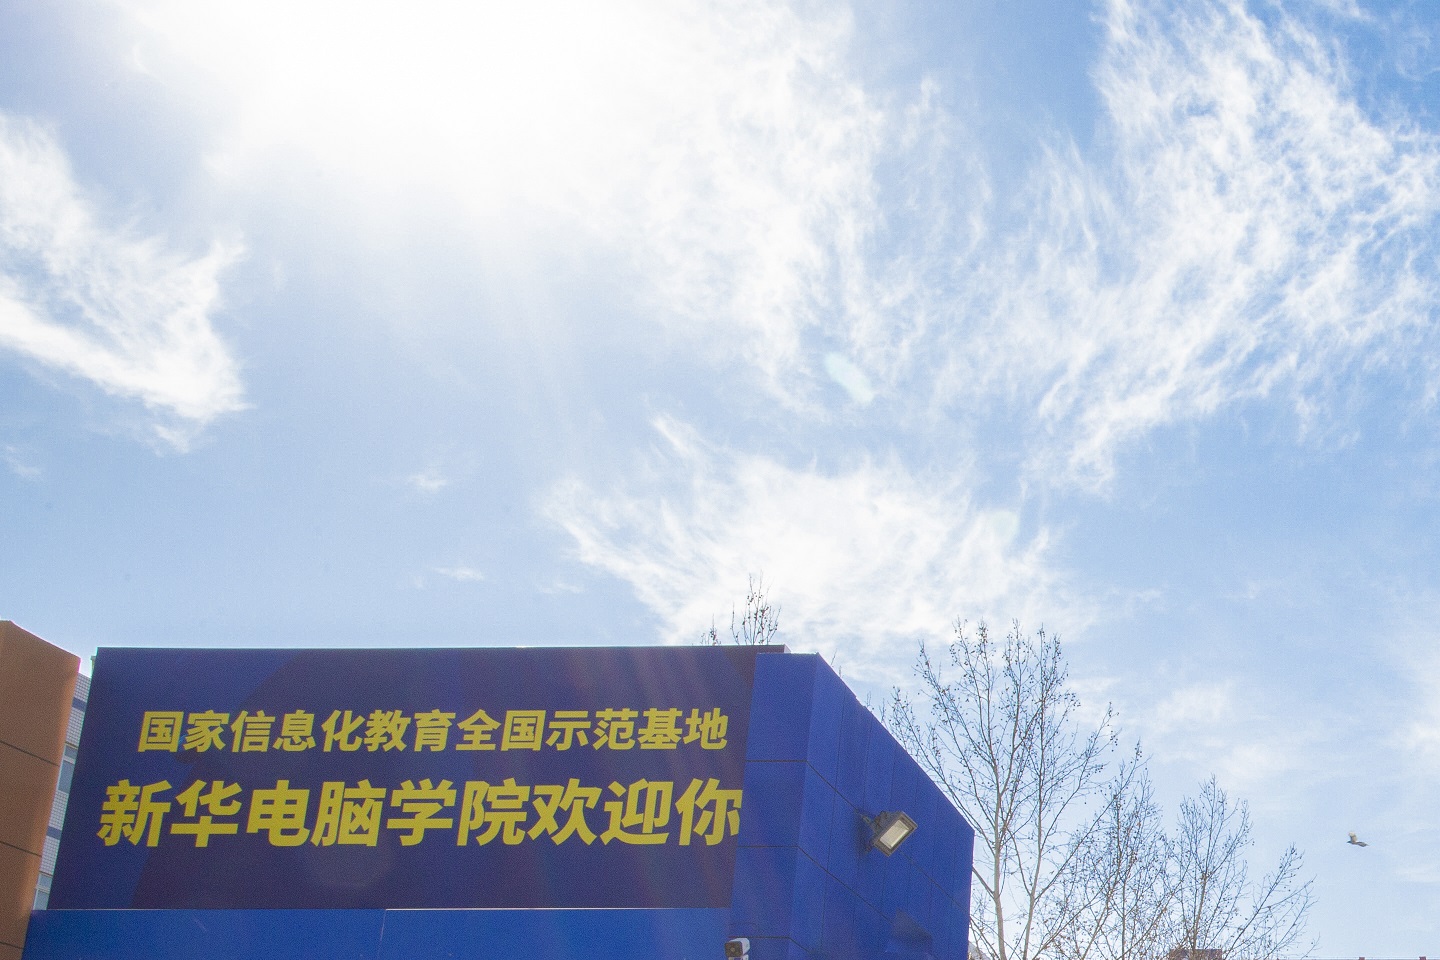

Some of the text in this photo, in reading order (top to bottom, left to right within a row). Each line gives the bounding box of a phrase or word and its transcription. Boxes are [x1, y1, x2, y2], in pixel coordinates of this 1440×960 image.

[137, 708, 729, 753] 国家信息化教育全国示范基地
[97, 777, 743, 848] 新华电脑学院欢迎你
